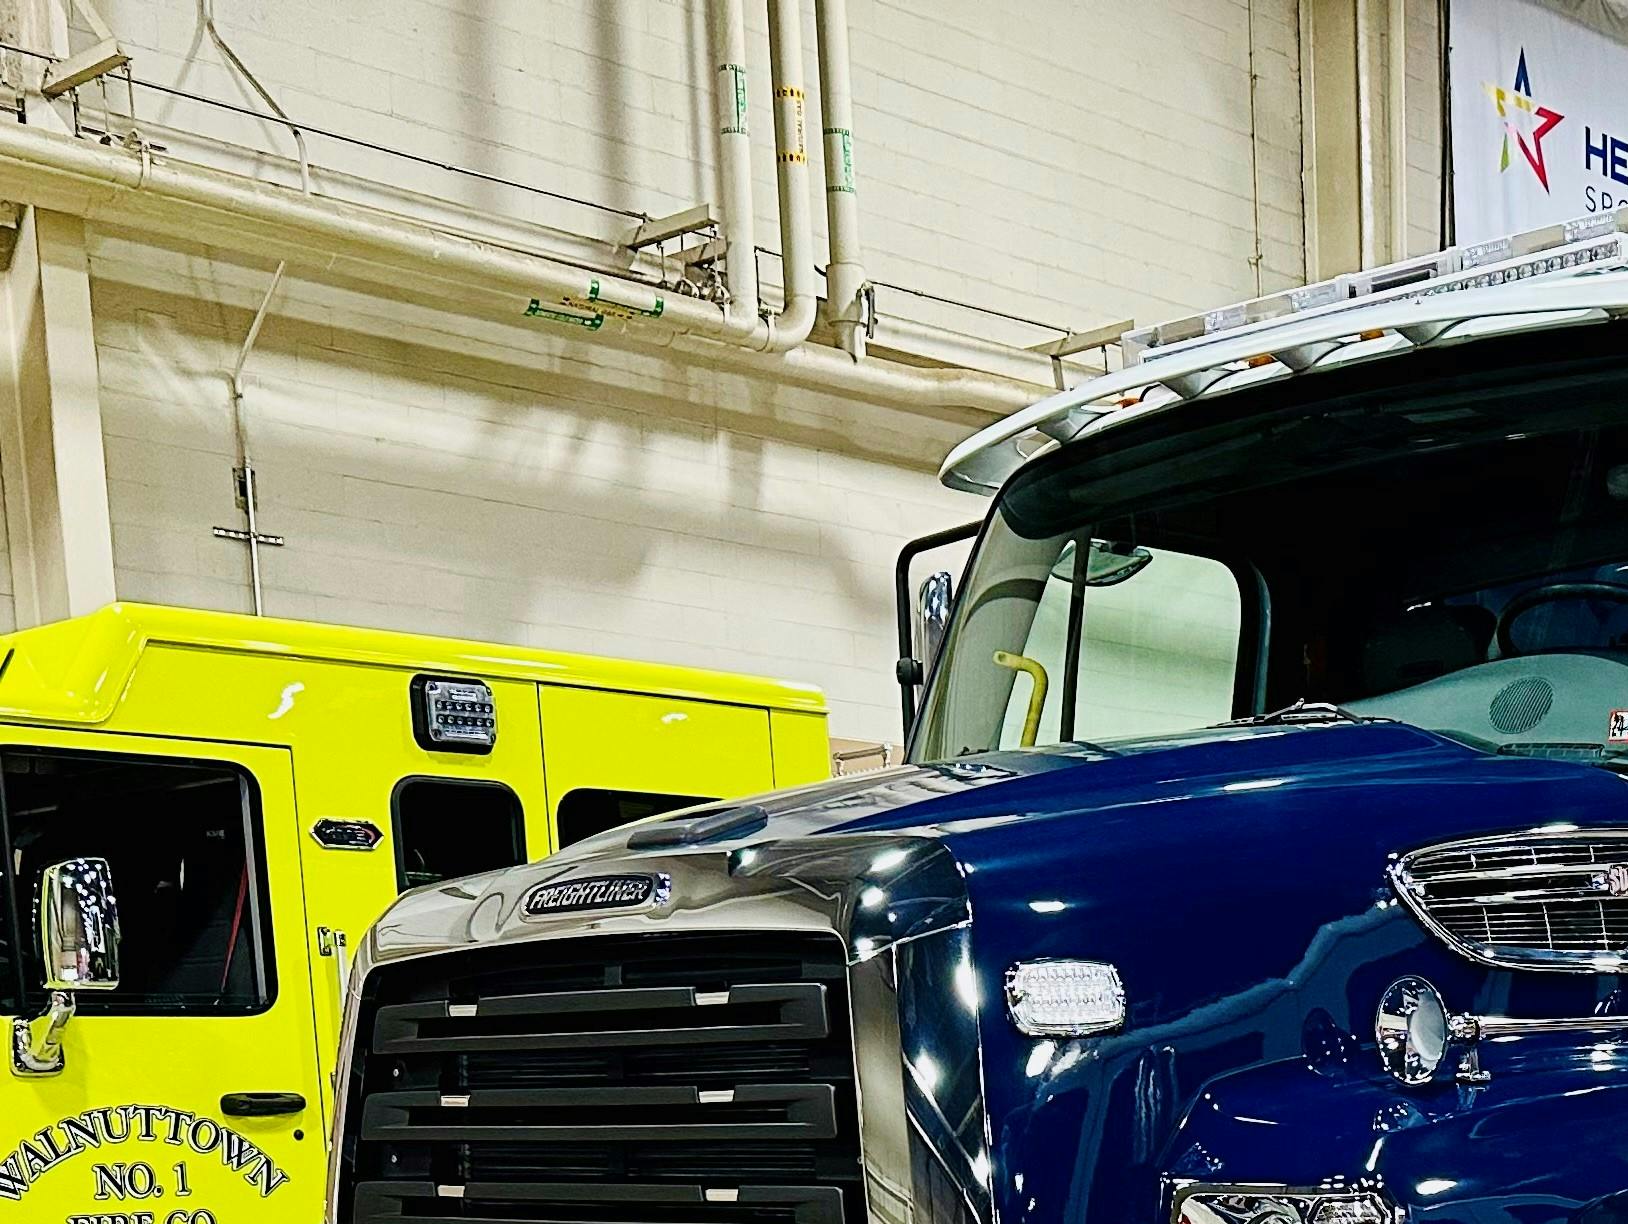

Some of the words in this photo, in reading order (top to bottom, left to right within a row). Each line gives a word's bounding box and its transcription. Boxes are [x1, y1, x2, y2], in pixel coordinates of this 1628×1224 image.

[529, 879, 650, 911] FREIGHTLINER
[0, 1103, 290, 1200] WALNUTTOWN
[93, 1162, 164, 1200] NO.
[173, 1161, 192, 1196] 1
